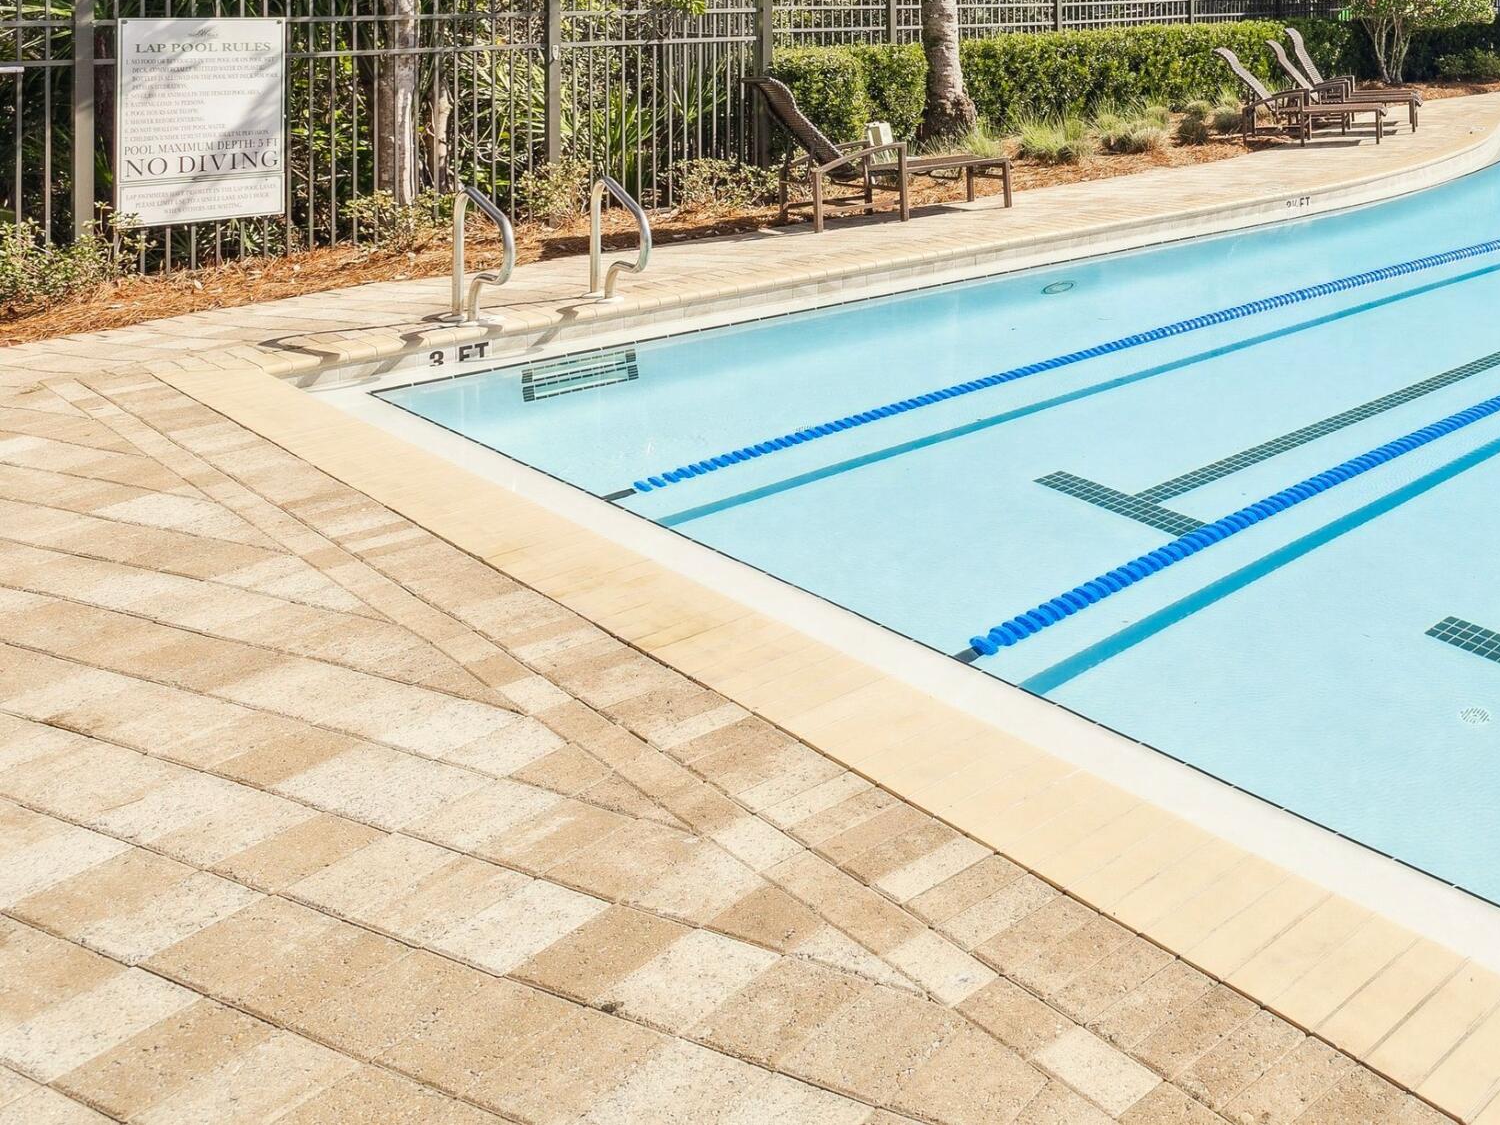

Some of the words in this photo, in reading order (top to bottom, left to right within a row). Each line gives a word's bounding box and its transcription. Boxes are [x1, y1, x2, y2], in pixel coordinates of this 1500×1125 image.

[135, 43, 166, 53] LAP
[171, 43, 218, 53] POOL
[222, 42, 272, 52] RULES
[125, 145, 154, 155] POOL
[158, 142, 214, 153] MAXIMUM
[217, 138, 255, 150] DEPTH:
[266, 138, 278, 147] FT
[124, 157, 168, 178] NO
[177, 150, 278, 174] DIVING
[429, 350, 444, 367] 3
[459, 341, 489, 362] FT
